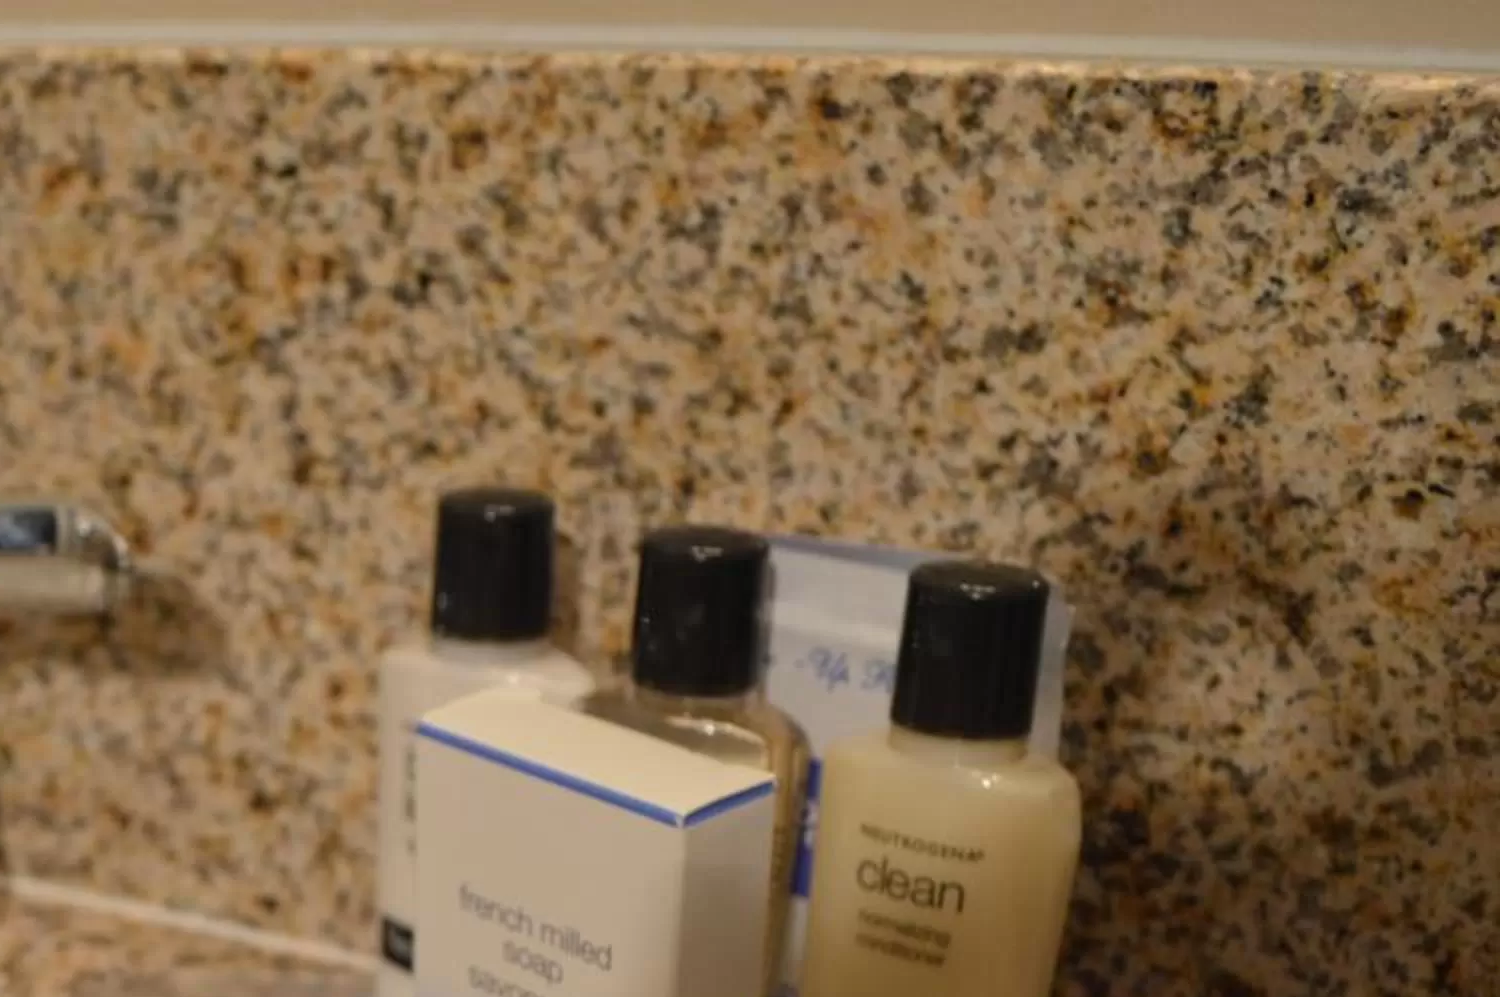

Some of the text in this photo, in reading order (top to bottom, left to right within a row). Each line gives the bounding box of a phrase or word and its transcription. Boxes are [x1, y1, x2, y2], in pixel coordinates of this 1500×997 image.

[856, 855, 965, 915] clean
[458, 881, 613, 973] french milled
[502, 940, 565, 986] soap
